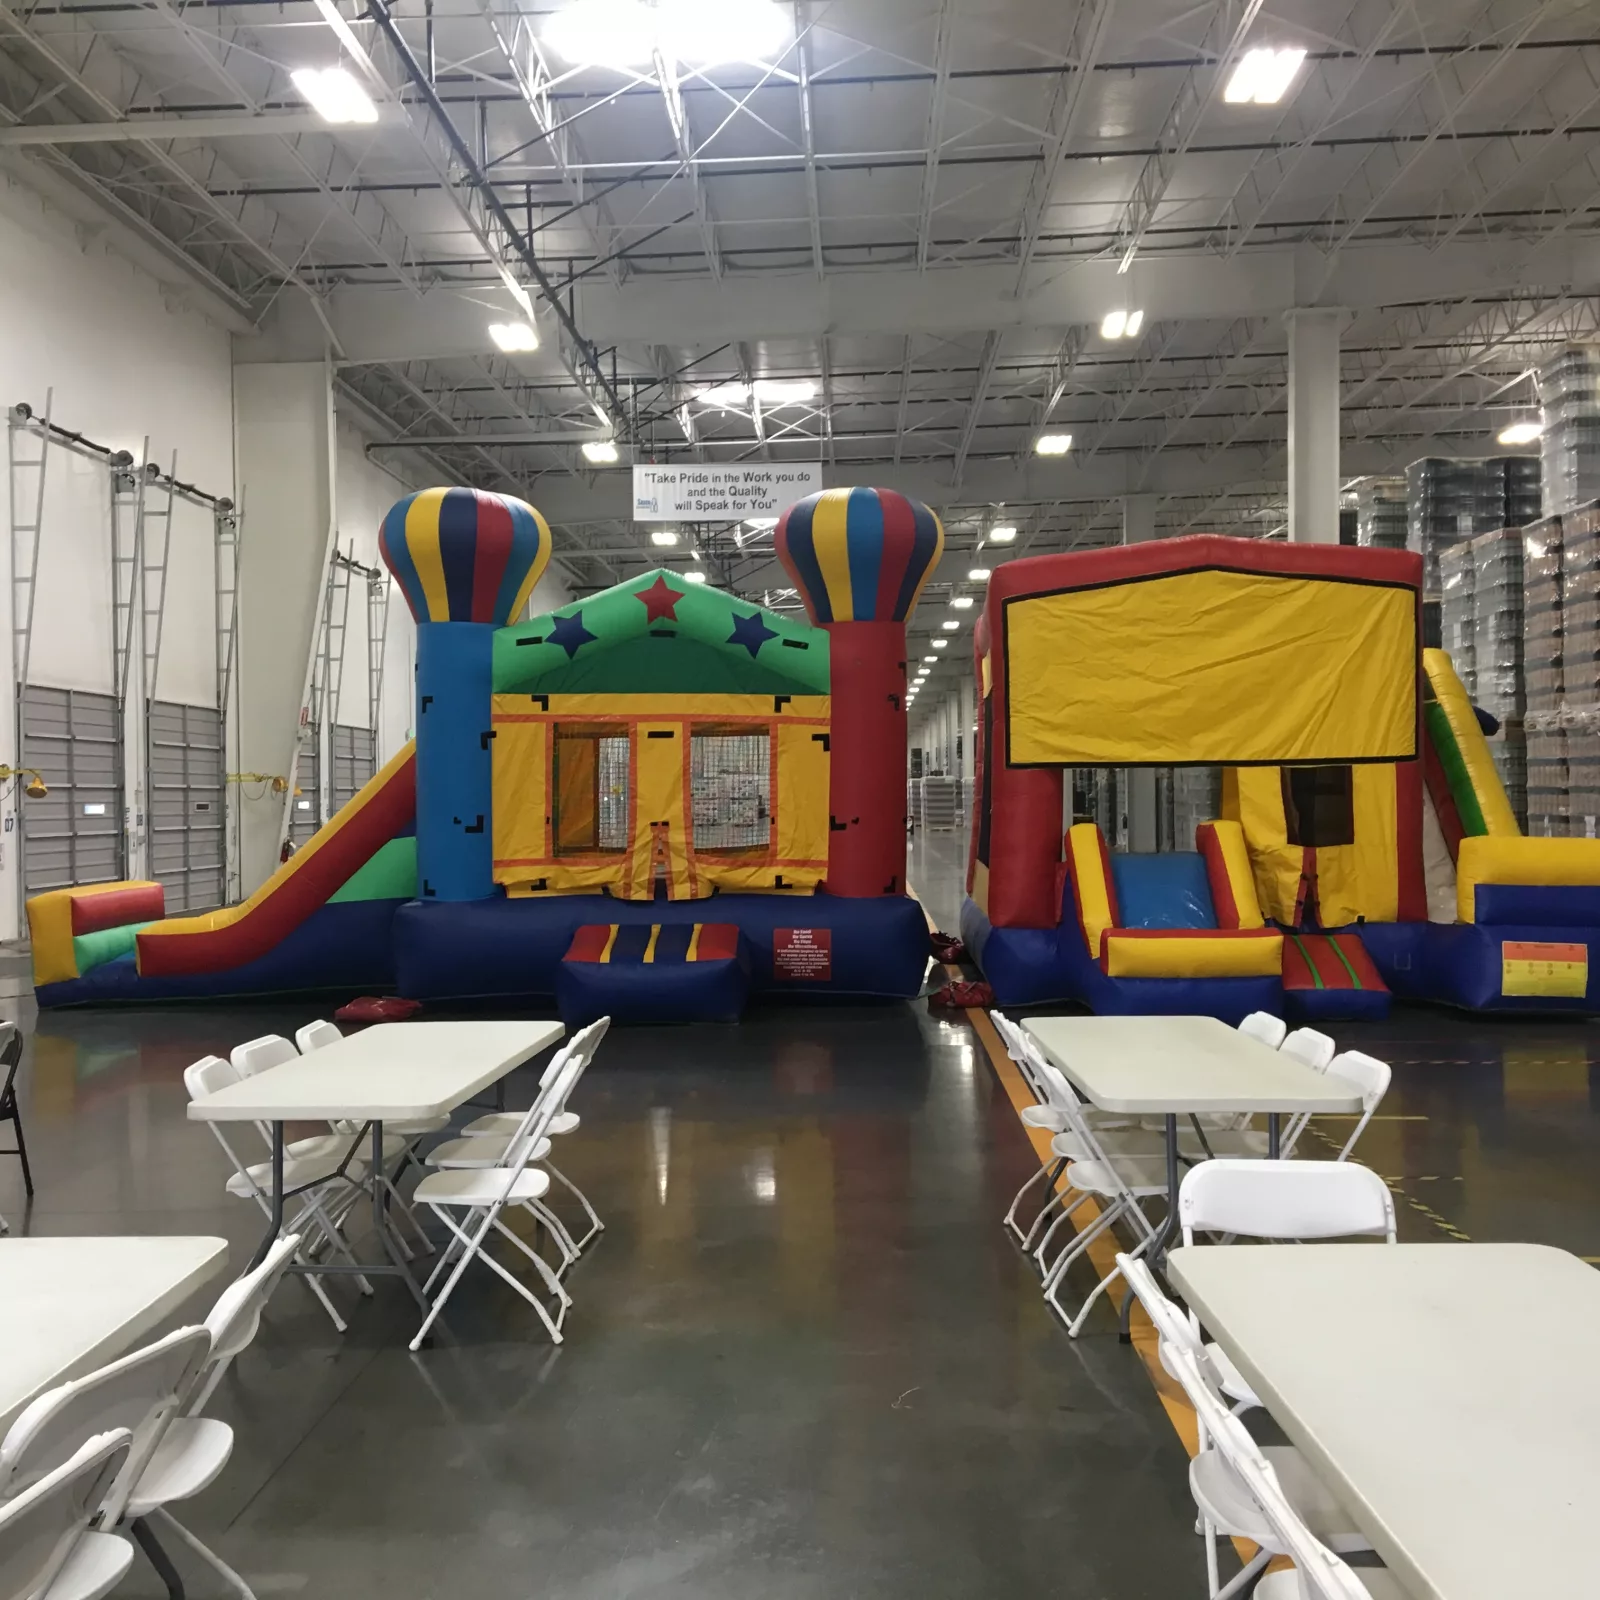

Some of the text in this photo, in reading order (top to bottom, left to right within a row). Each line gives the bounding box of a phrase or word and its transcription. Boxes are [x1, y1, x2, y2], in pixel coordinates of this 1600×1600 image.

[645, 472, 810, 484] "Take Pride in the Work you do
[687, 486, 767, 498] and the Quality
[674, 499, 777, 512] will Speak for You"
